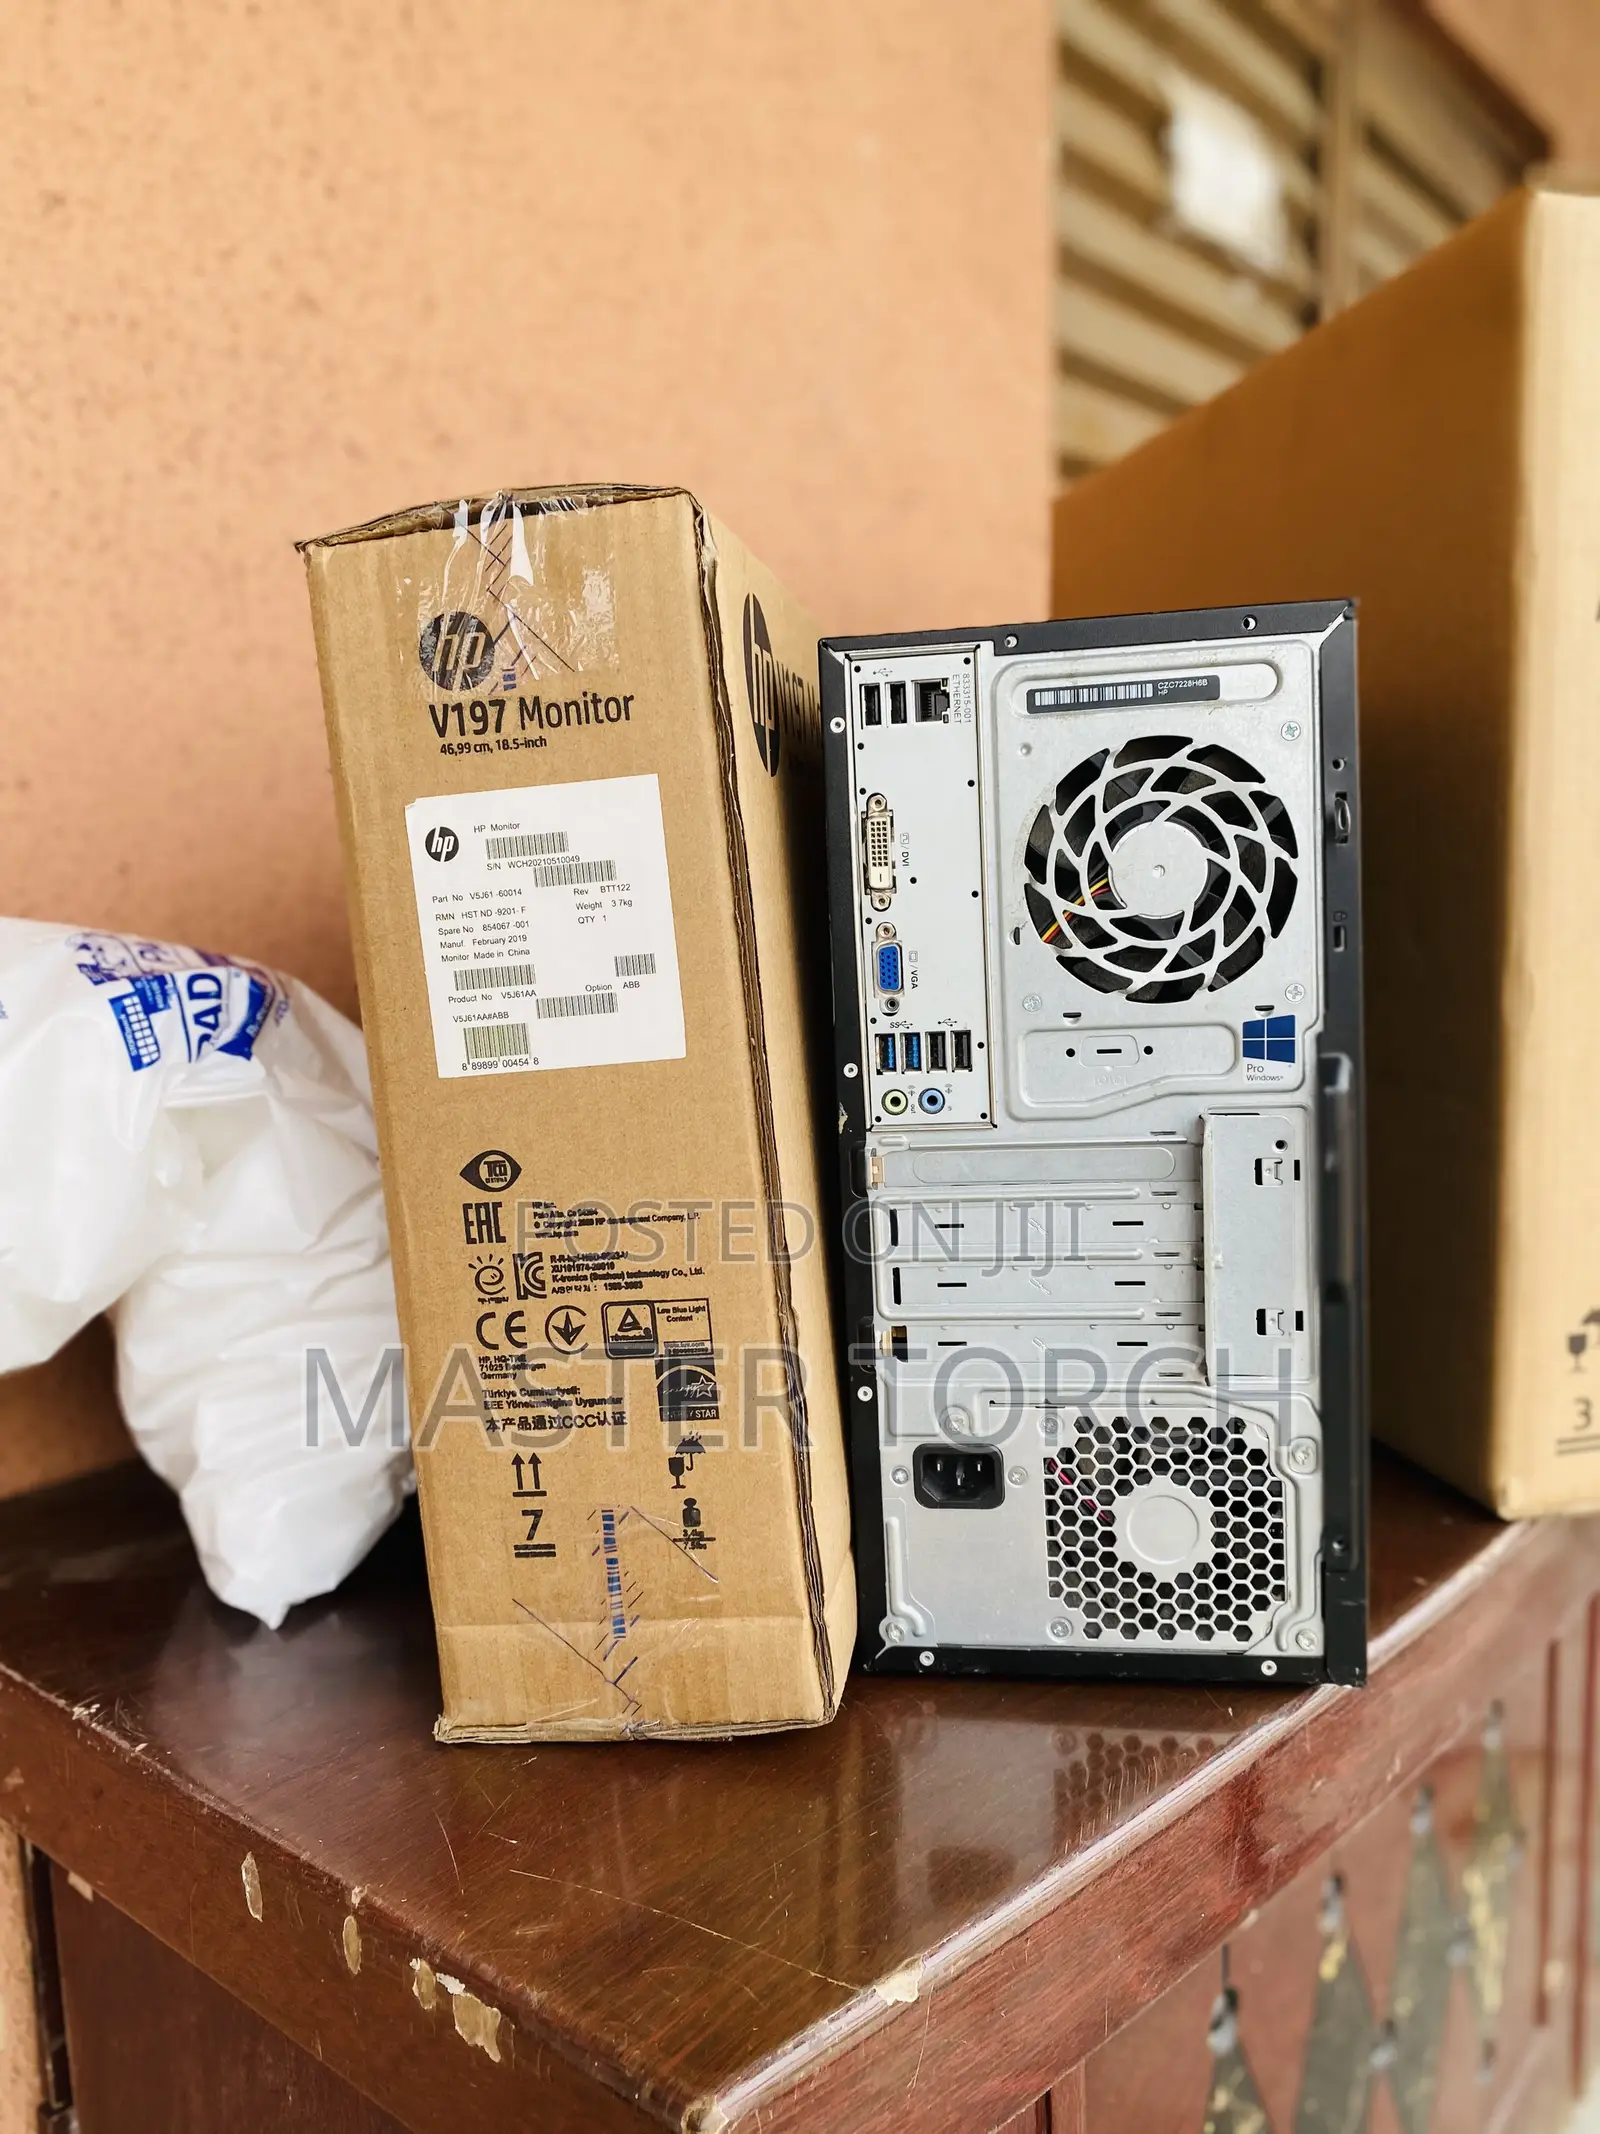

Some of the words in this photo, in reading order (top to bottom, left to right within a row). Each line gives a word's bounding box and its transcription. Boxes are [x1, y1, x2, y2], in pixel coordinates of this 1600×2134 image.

[952, 674, 962, 724] ETHERNET
[429, 699, 506, 738] V197
[518, 691, 635, 731] Monitor
[440, 741, 471, 756] 46,99
[473, 740, 493, 754] cm,
[495, 736, 547, 751] 18.5-inch
[473, 824, 486, 833] HP
[490, 822, 520, 832] Monitor
[428, 826, 457, 862] hp
[901, 851, 910, 867] DVI
[486, 863, 502, 871] S/N
[573, 888, 589, 896] Rev
[600, 883, 631, 893] BTT122
[432, 895, 448, 904] Part
[452, 894, 464, 902] No
[469, 890, 493, 900] V5J61
[575, 901, 602, 912] Weight
[435, 912, 455, 922] RMN
[577, 916, 596, 926] QTY
[603, 914, 608, 922] 1
[438, 927, 461, 936] Spare
[462, 926, 475, 934] No
[482, 922, 511, 932] 854067
[472, 936, 506, 947] February
[508, 934, 528, 943] 2019
[441, 953, 470, 963] Monitor
[473, 951, 496, 960] Made
[507, 947, 531, 956] China
[622, 980, 641, 990] ABB
[910, 970, 919, 989] VGA
[448, 995, 478, 1004] Product
[481, 993, 493, 1001] No
[500, 988, 537, 999] V5J61AA
[1246, 1063, 1265, 1073] Pro
[652, 1213, 686, 1222] Company,
[671, 1268, 688, 1277] Co.,
[657, 1306, 671, 1314] Low
[688, 1305, 706, 1313] Light
[666, 1315, 693, 1323] Content
[480, 1372, 517, 1380] Germany
[484, 1400, 504, 1410] EEE
[695, 1409, 717, 1418] STAR
[521, 1509, 543, 1541] 7
